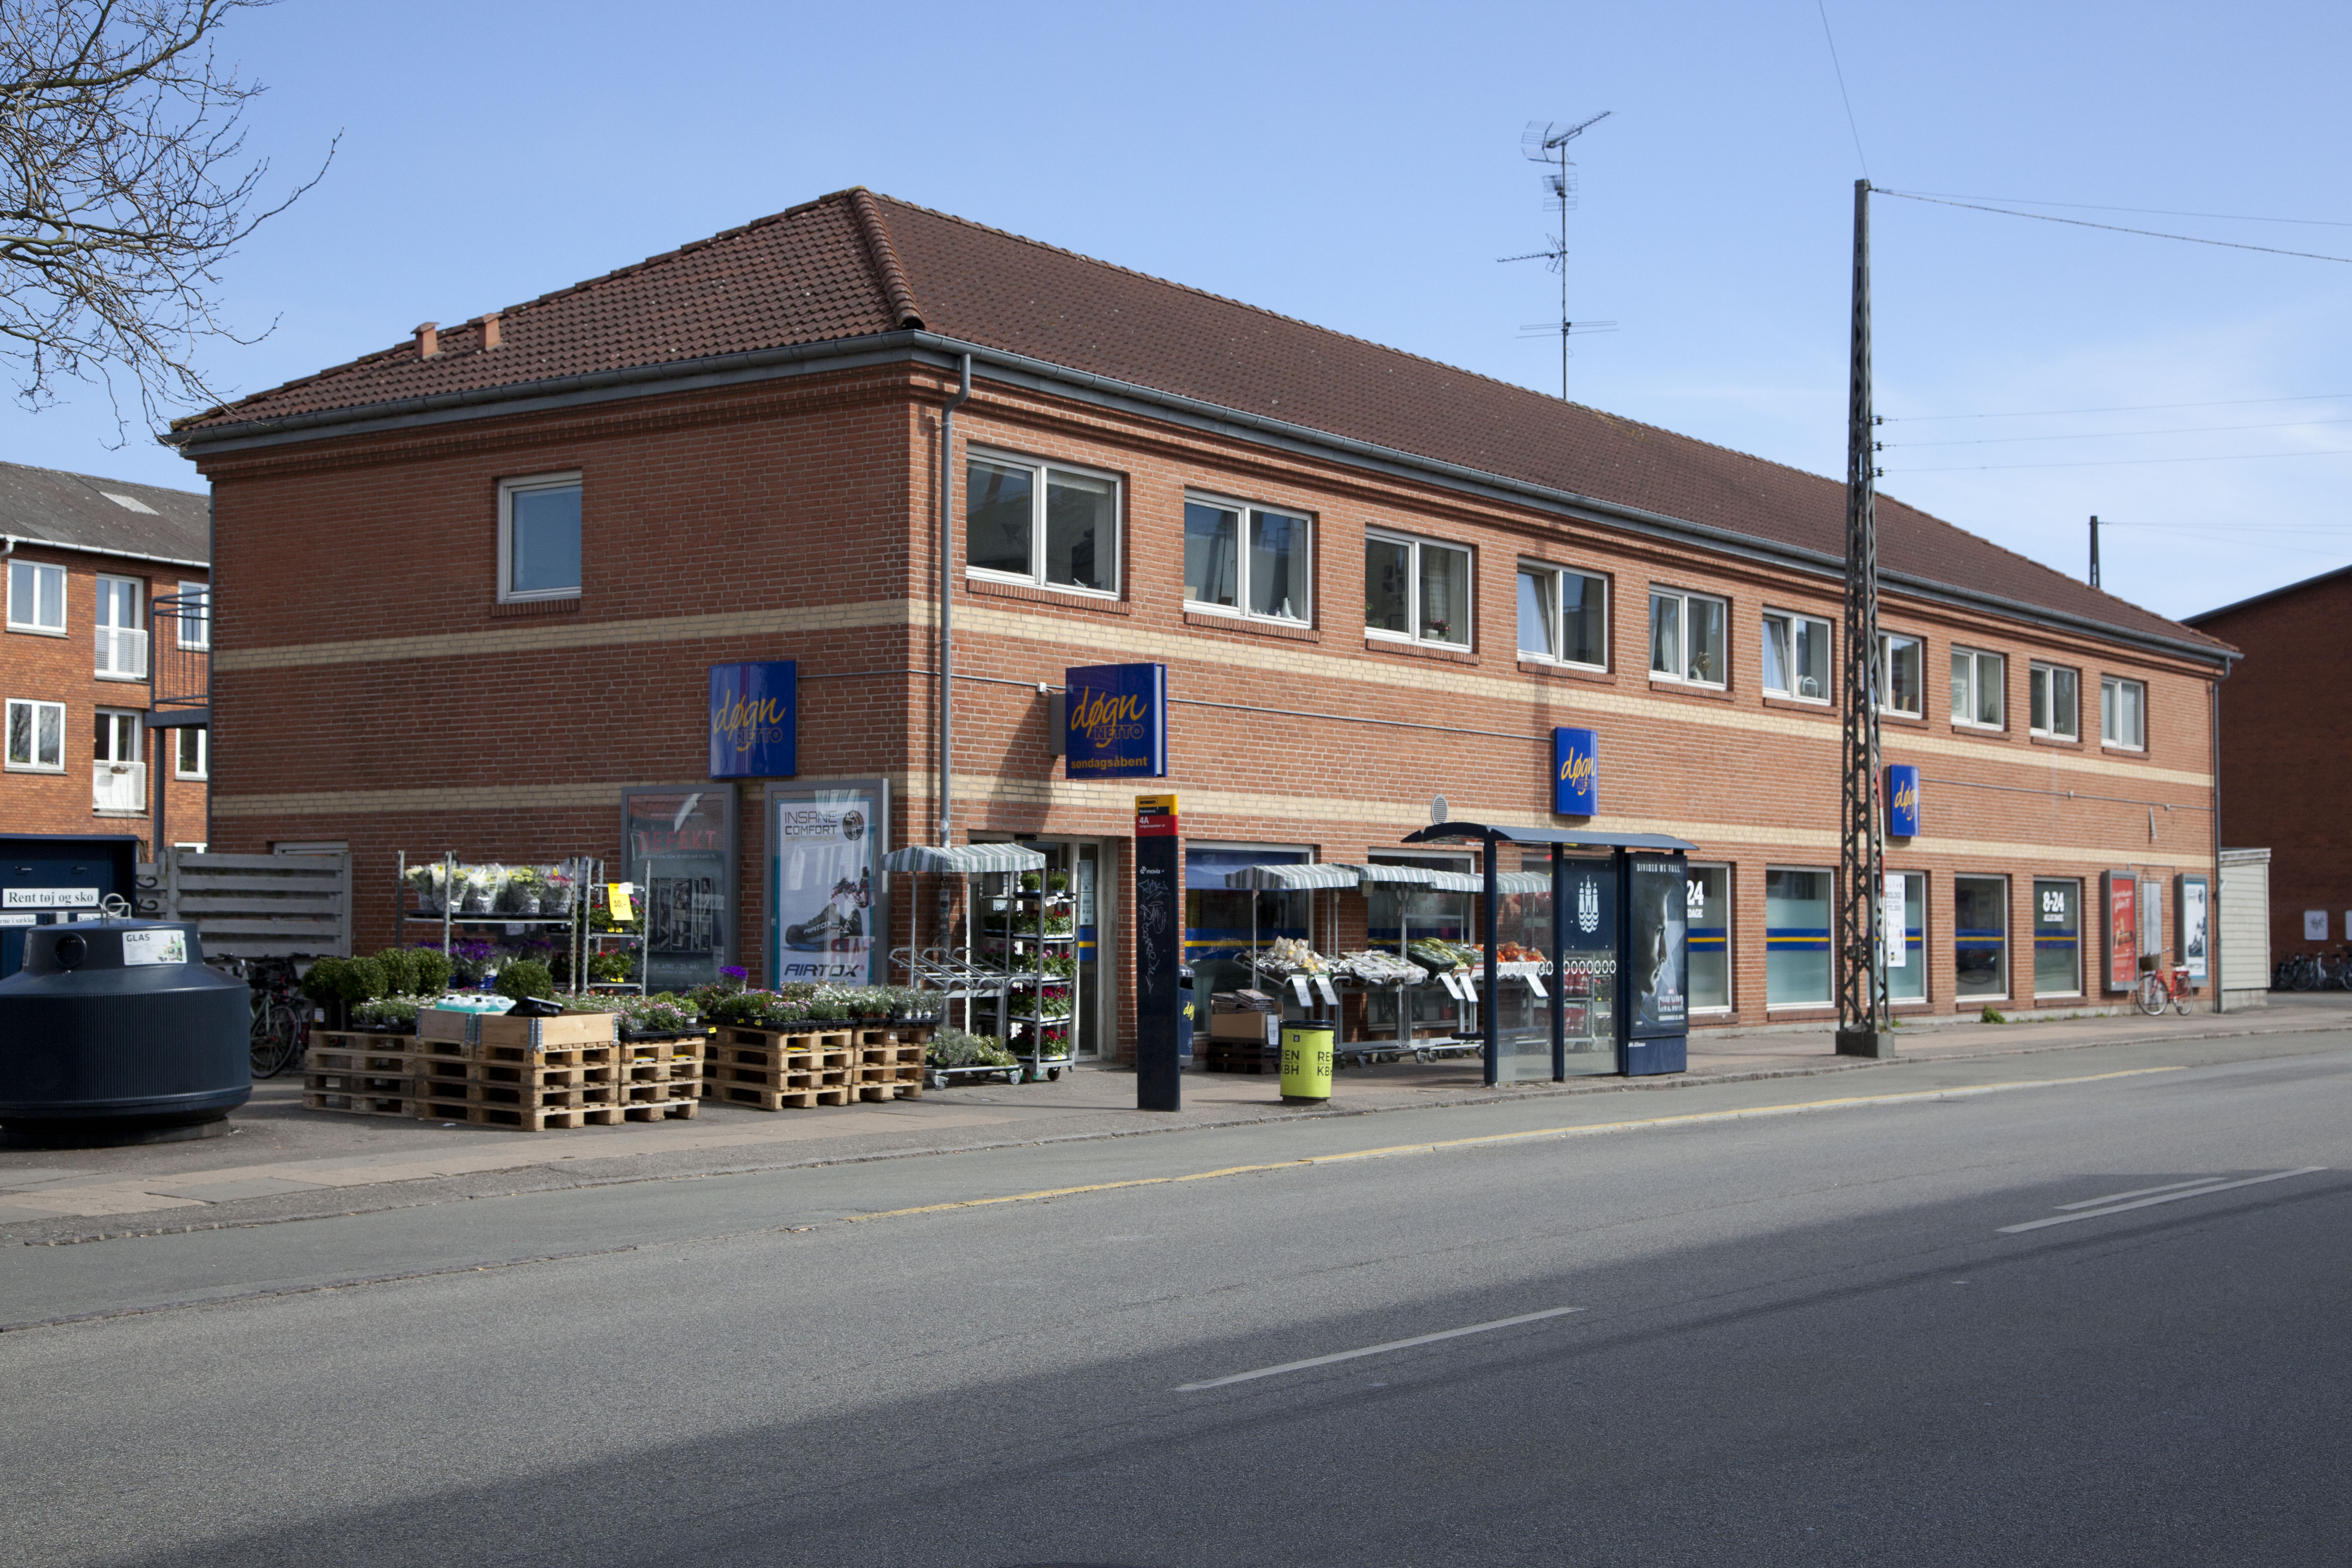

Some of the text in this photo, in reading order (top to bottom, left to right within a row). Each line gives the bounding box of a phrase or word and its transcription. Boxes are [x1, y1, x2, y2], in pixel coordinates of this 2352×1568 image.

[714, 689, 786, 752] døgn
[1071, 686, 1147, 748] døgn
[735, 727, 783, 743] NETTO
[1094, 724, 1144, 740] NETTO
[1071, 755, 1148, 770] søndagsåbent
[1561, 746, 1596, 796] døgn
[785, 811, 837, 824] INSANE
[785, 825, 837, 835] COMFORT
[639, 830, 716, 851] DEFEKT
[1637, 863, 1680, 873] DIVIDED WE FALL
[9, 892, 93, 905] Rent tøj og sko
[2043, 891, 2065, 912] 8-24
[804, 921, 831, 934] AIRTOX
